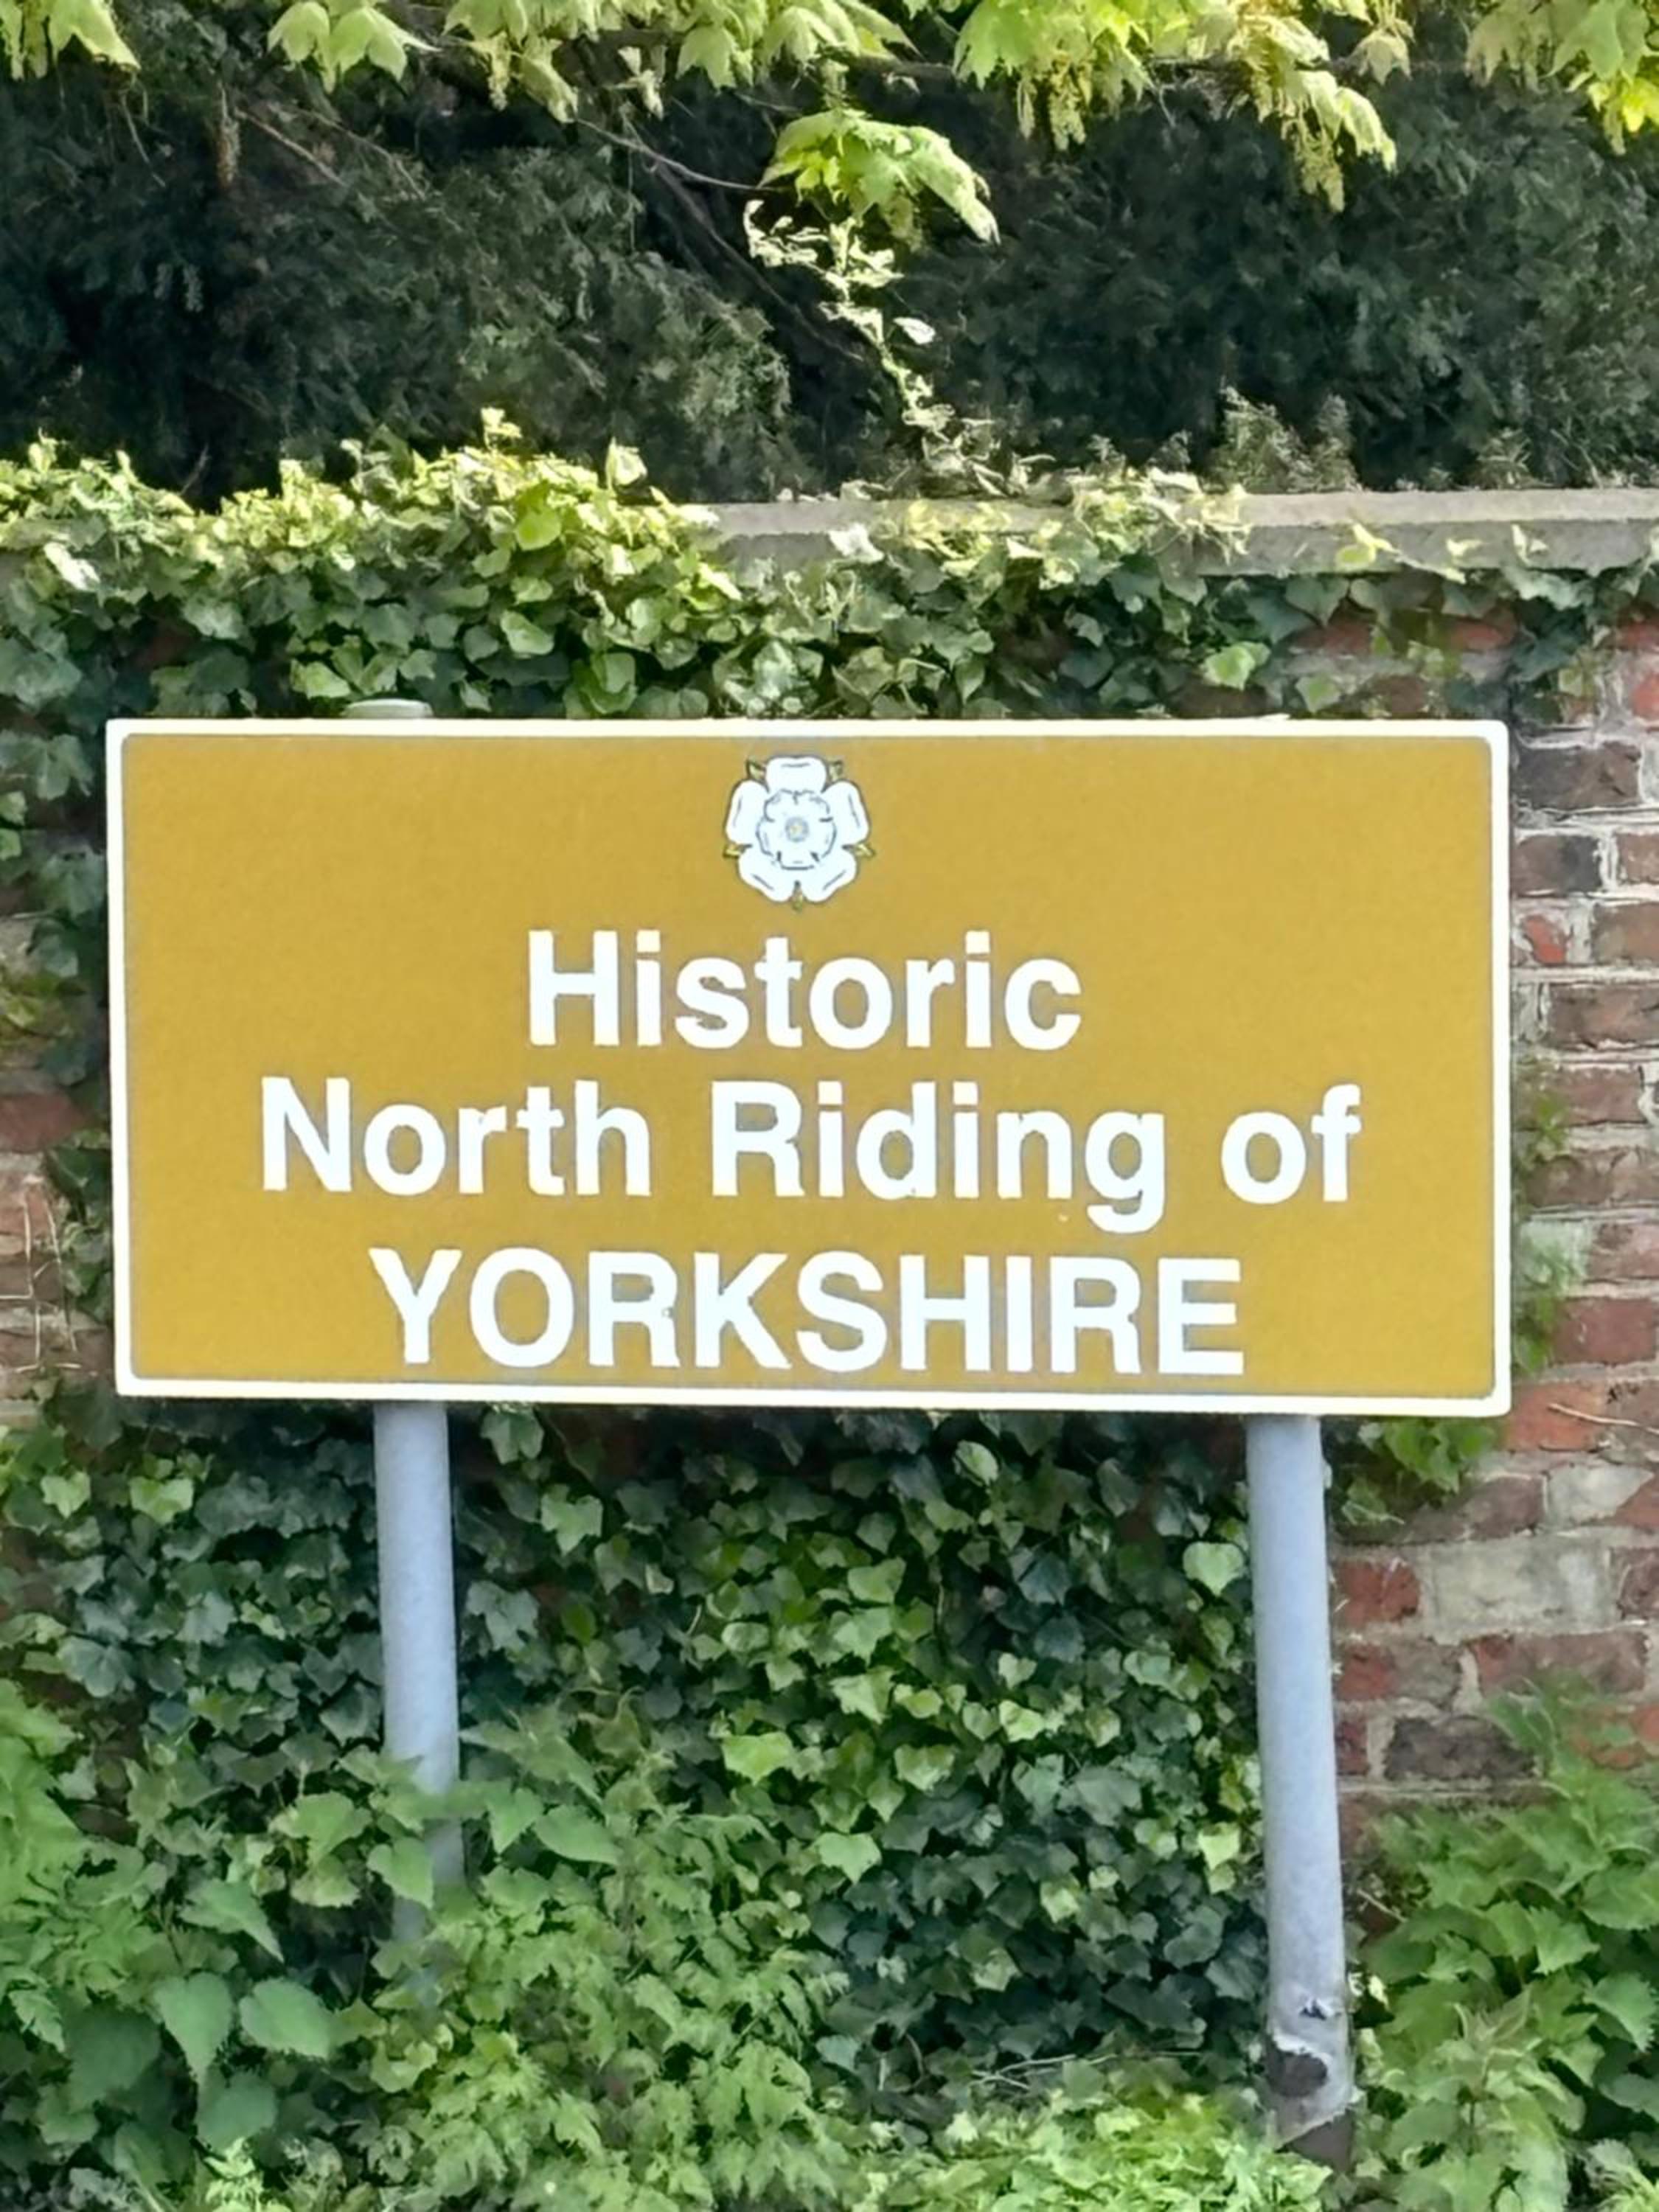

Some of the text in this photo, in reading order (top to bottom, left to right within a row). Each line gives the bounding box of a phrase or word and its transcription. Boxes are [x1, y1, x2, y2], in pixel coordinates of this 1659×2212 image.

[528, 929, 1082, 1052] Historic
[261, 1075, 1363, 1235] North Riding of
[369, 1247, 1245, 1377] YORKSHIRE
